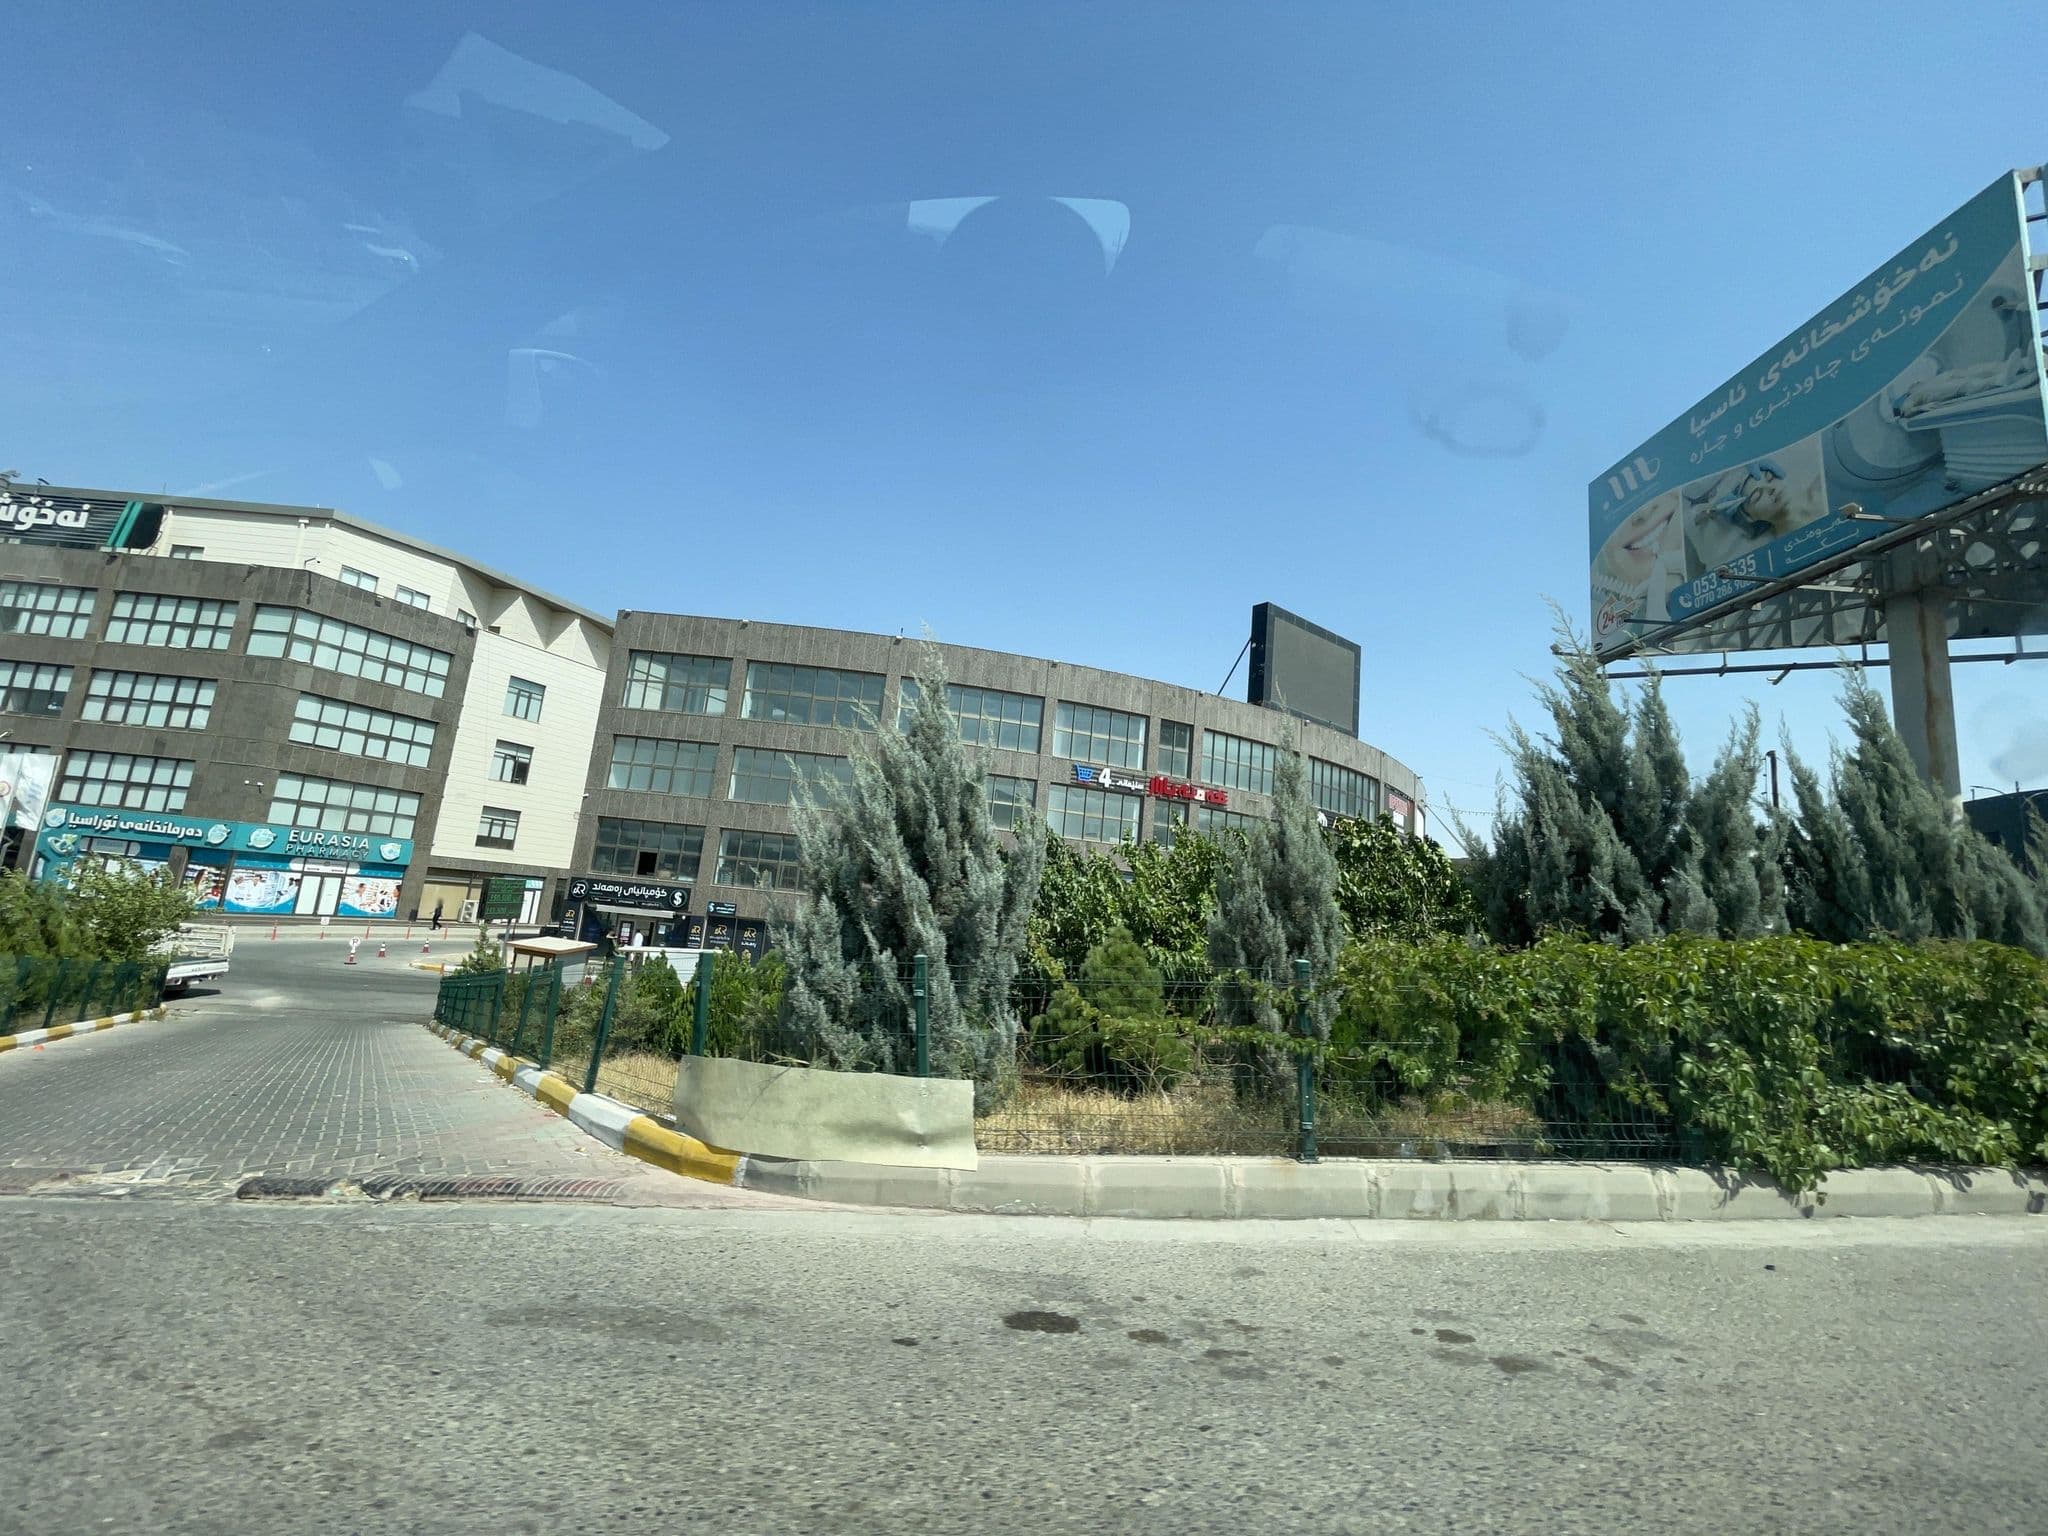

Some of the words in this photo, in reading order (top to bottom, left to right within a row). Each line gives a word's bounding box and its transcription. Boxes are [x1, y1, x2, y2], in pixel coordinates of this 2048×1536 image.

[1693, 573, 1717, 596] 053
[1098, 768, 1113, 788] 4
[288, 830, 370, 850] EURASIA
[286, 843, 369, 861] PHARMACY
